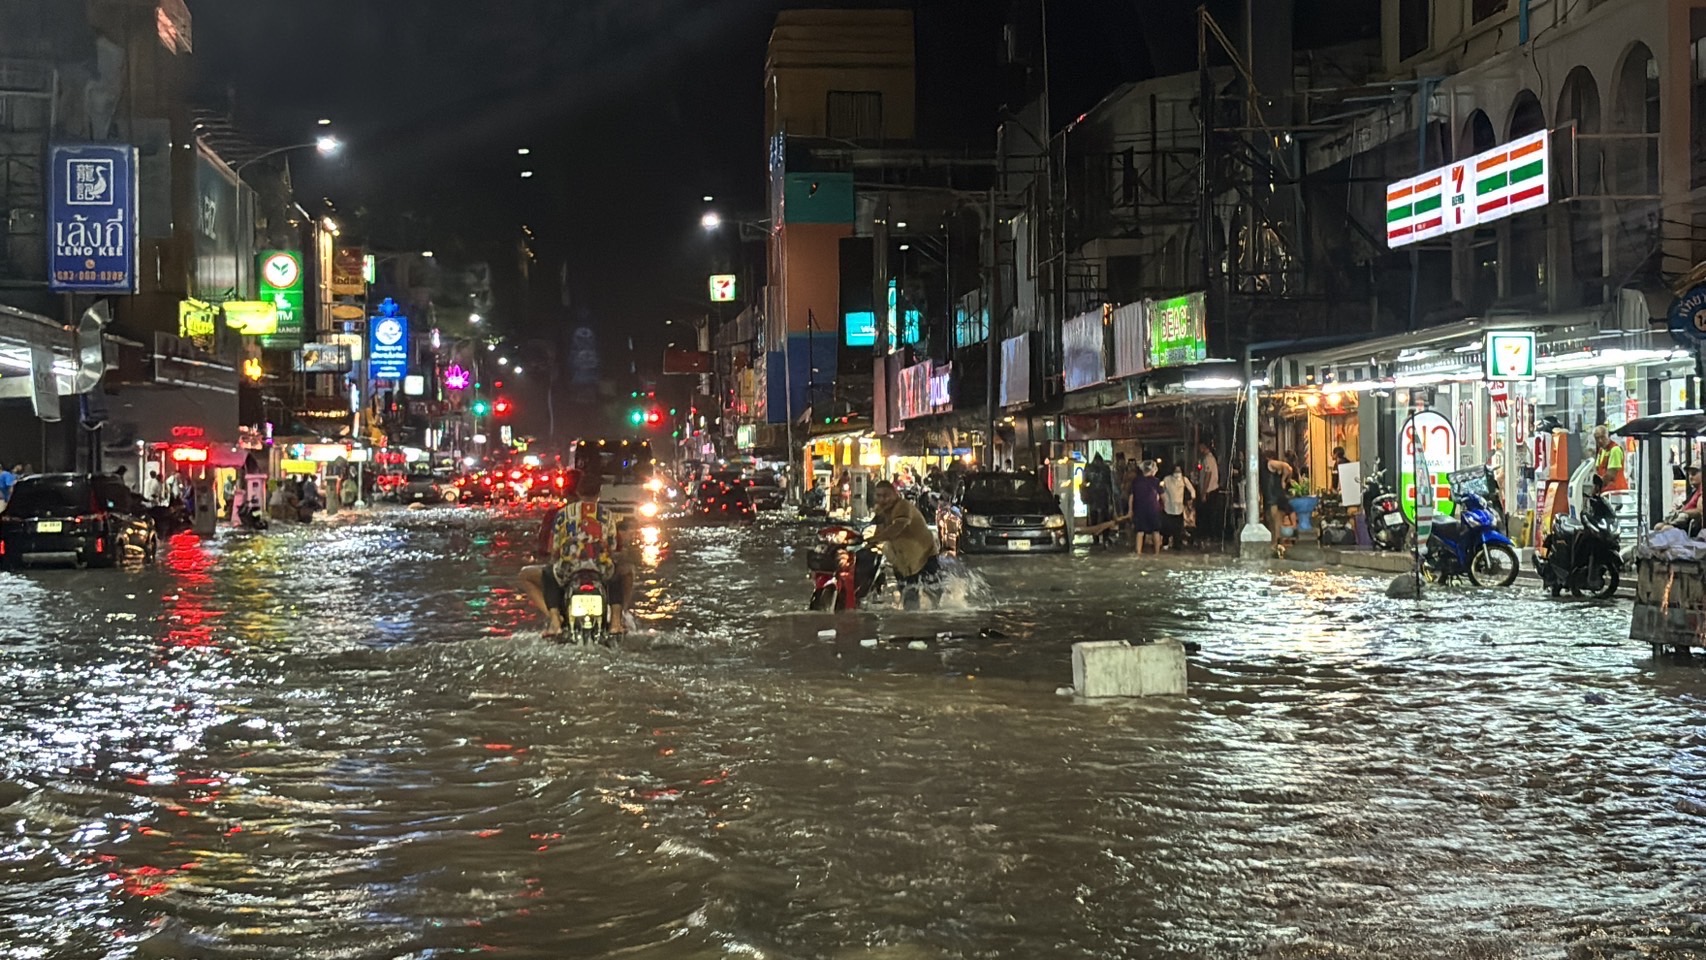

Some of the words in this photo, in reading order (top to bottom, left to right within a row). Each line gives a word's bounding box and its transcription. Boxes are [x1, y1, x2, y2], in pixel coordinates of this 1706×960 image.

[57, 247, 93, 256] LENG
[99, 247, 123, 256] KEE
[277, 311, 292, 321] TM
